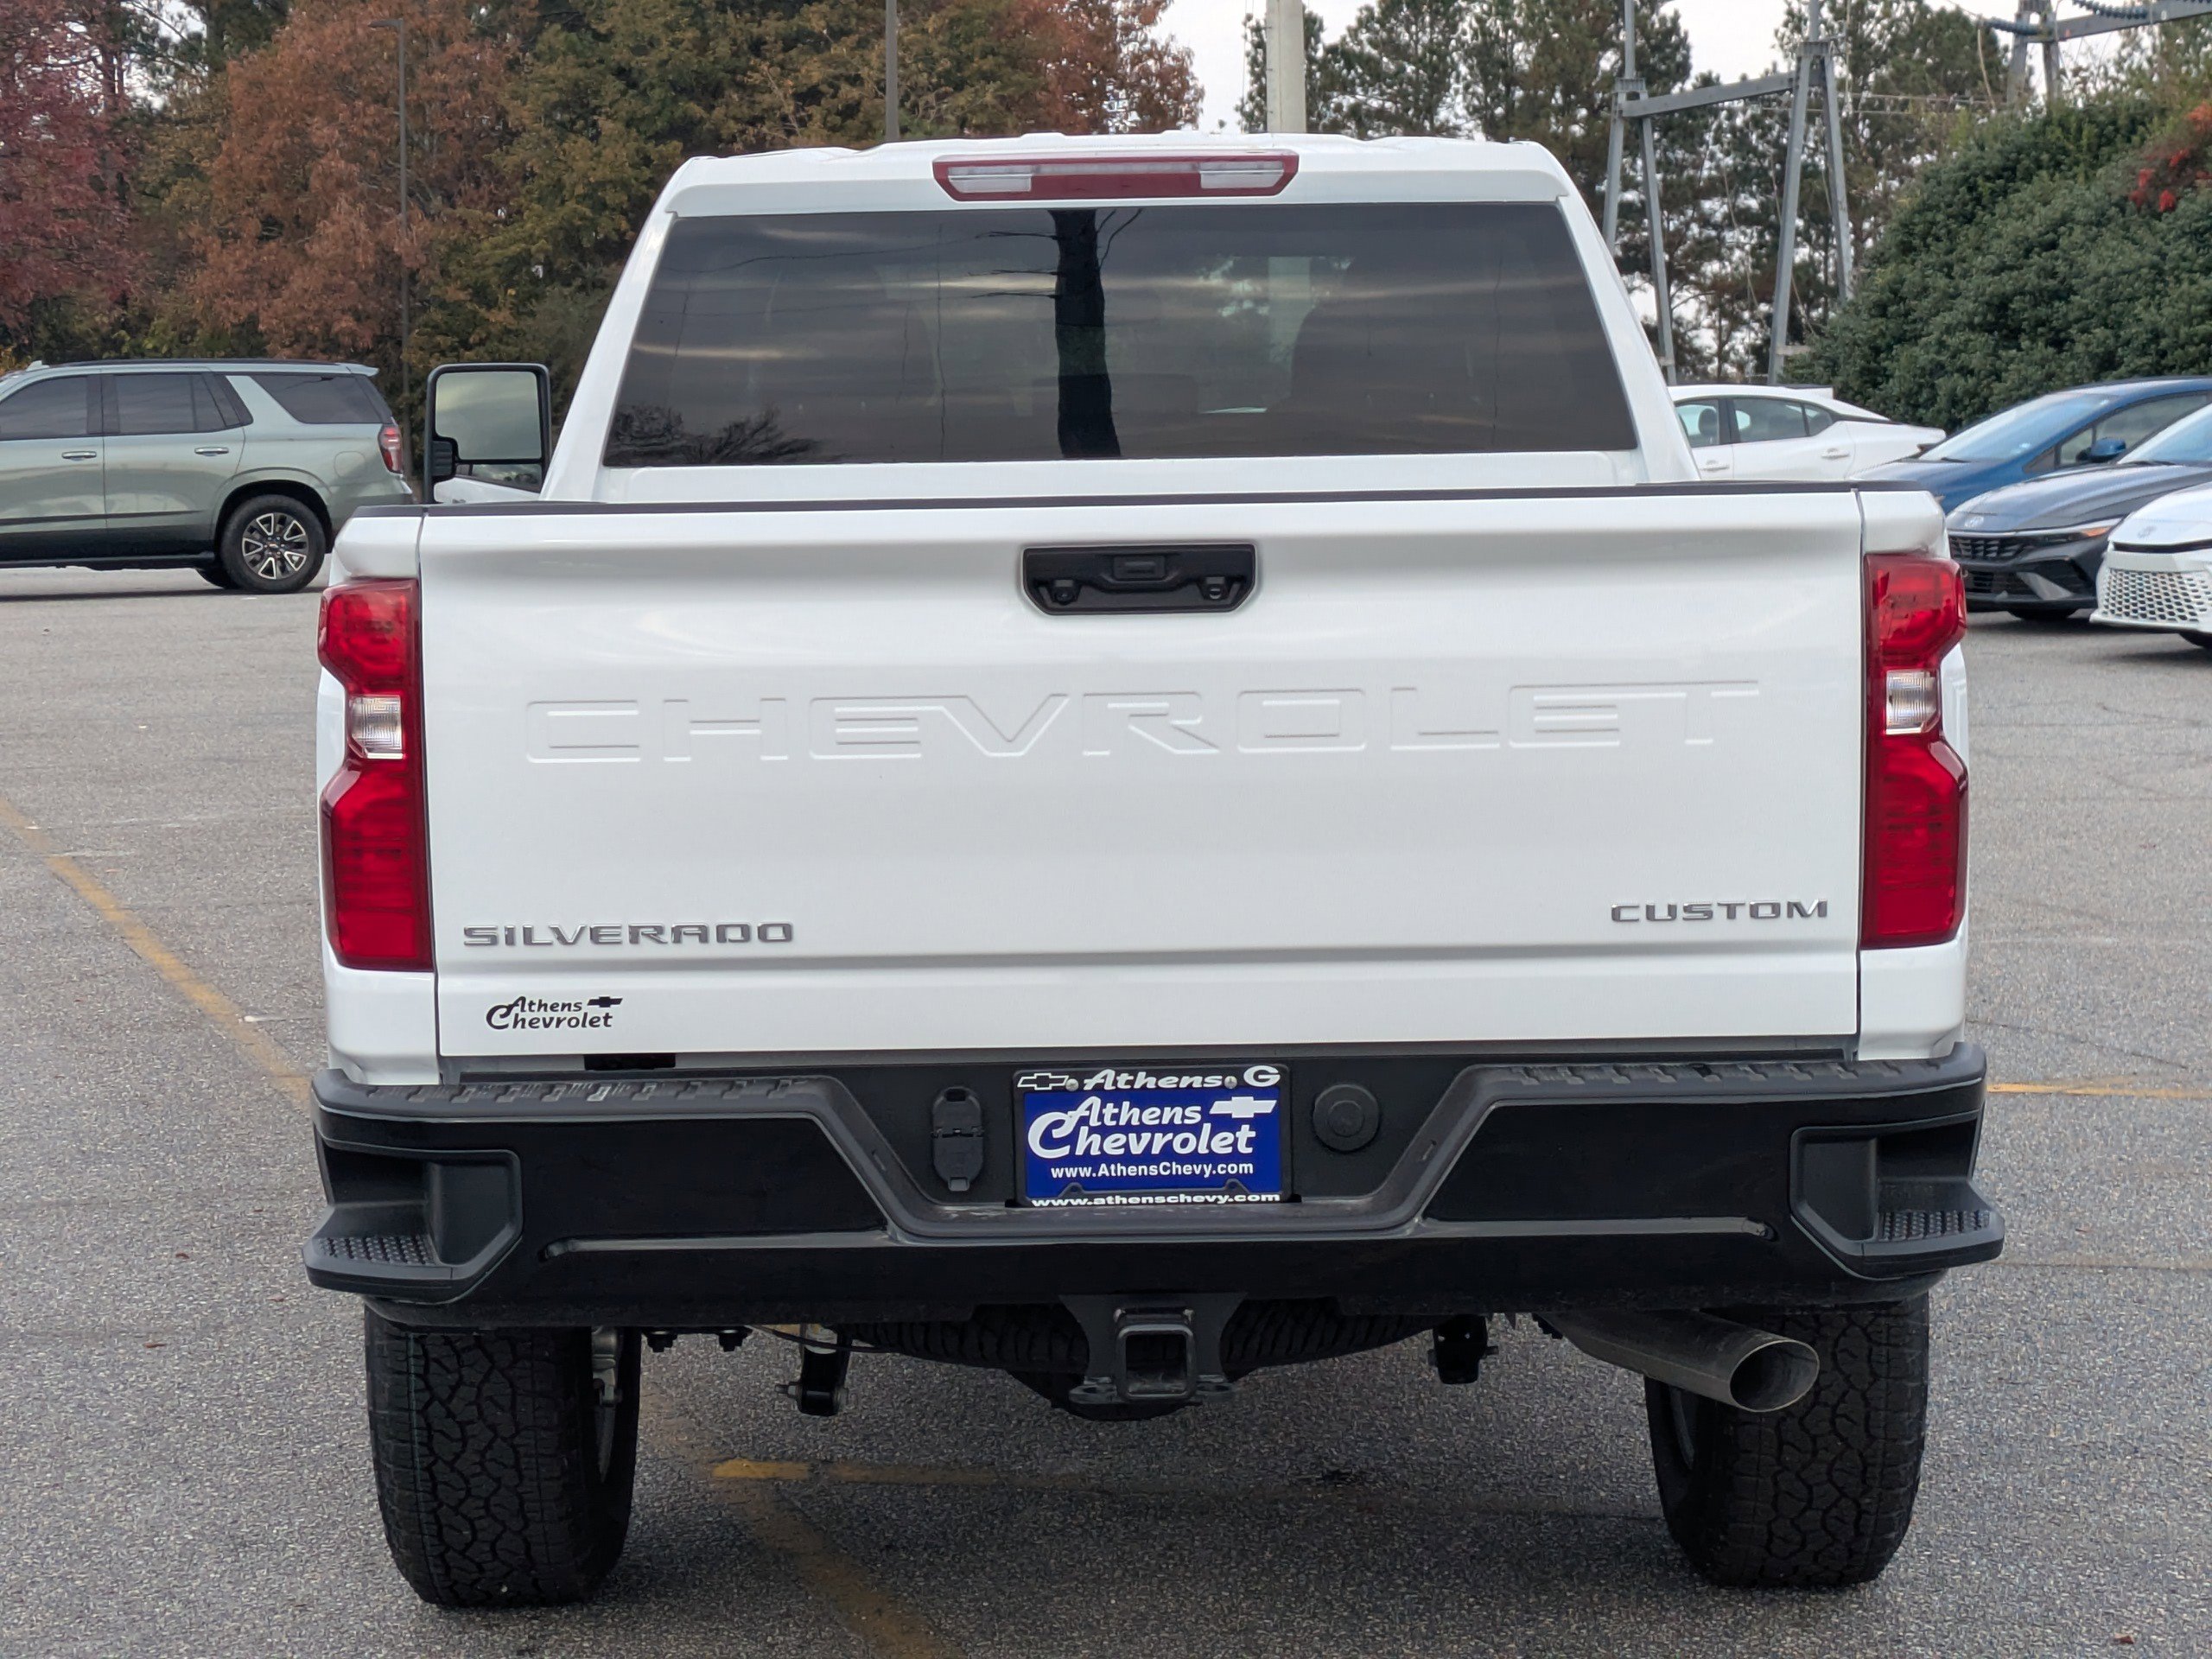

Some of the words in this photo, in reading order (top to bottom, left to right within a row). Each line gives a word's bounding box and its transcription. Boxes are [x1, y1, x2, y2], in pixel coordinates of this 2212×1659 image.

[526, 681, 1759, 765] CHEVROLET
[1611, 899, 1828, 922] CUSTOM
[464, 923, 793, 946] SILVERADO
[486, 1003, 613, 1030] Chevrolet
[506, 996, 582, 1013] Athens
[1084, 1069, 1223, 1090] Athens
[1243, 1065, 1281, 1087] G
[1067, 1096, 1202, 1126] Athens
[1027, 1111, 1256, 1159] Chevrolet
[1051, 1162, 1254, 1178] www.AthensChevy.com
[1031, 1192, 1281, 1207] www.athenschevy.com
